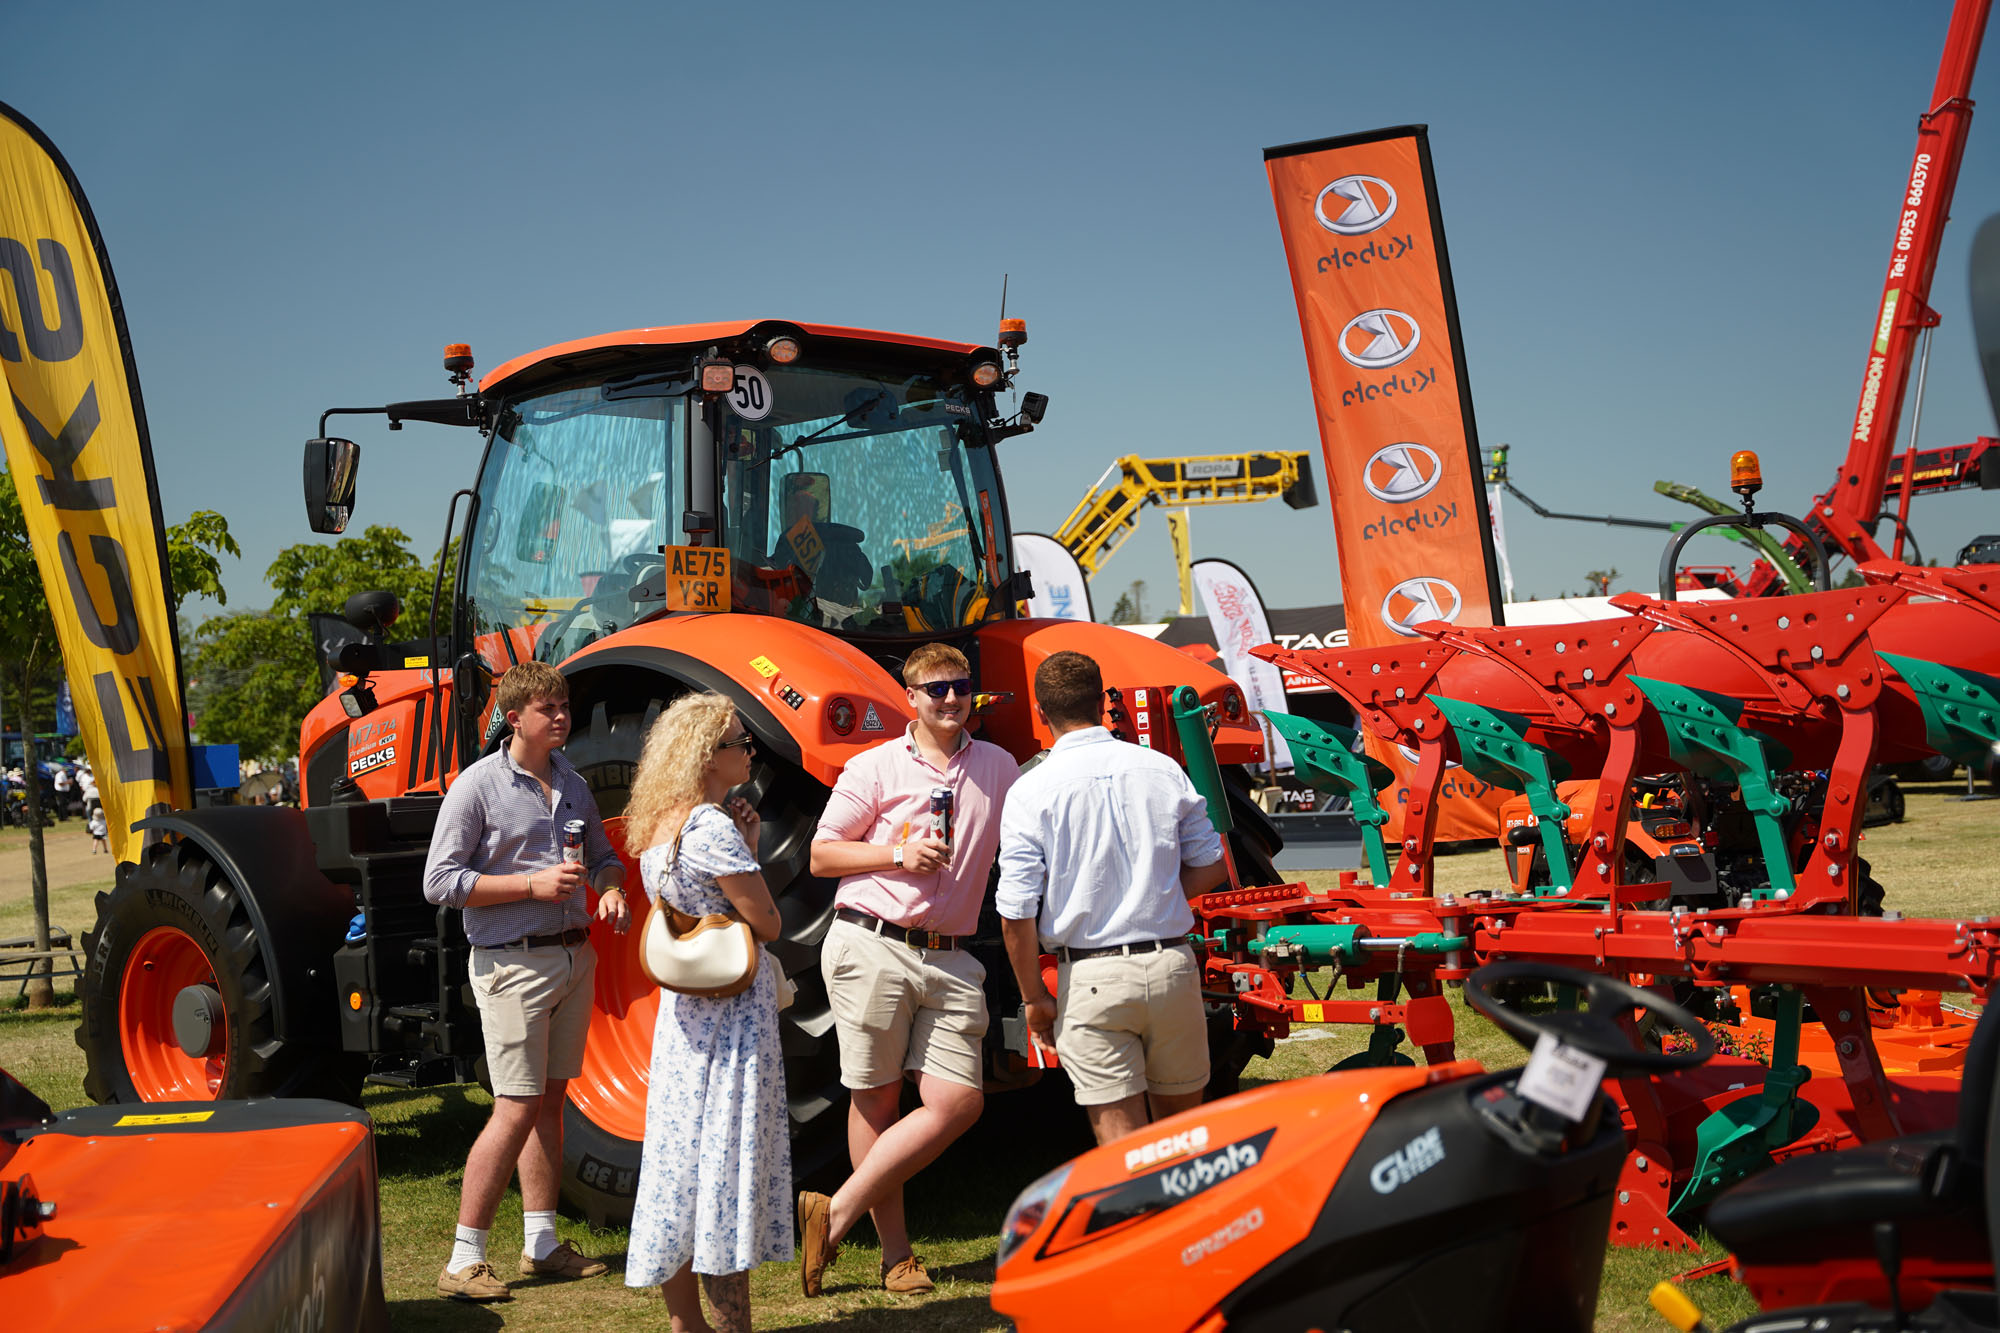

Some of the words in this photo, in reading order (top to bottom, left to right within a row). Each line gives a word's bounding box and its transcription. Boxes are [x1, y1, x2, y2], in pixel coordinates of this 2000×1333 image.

[1907, 153, 1931, 207] 860370
[1897, 209, 1918, 251] 01953
[1889, 253, 1908, 279] Tel:
[1854, 356, 1885, 442] ANDERSON
[1878, 300, 1896, 342] ACCESS
[735, 375, 764, 410] 50
[1192, 463, 1232, 475] ROPA
[672, 550, 725, 577] AE75
[679, 580, 719, 607] YSR
[350, 718, 396, 747] M7-174
[351, 746, 395, 773] PECKS
[1125, 1126, 1209, 1170] PECKS
[1160, 1143, 1259, 1196] Kubota
